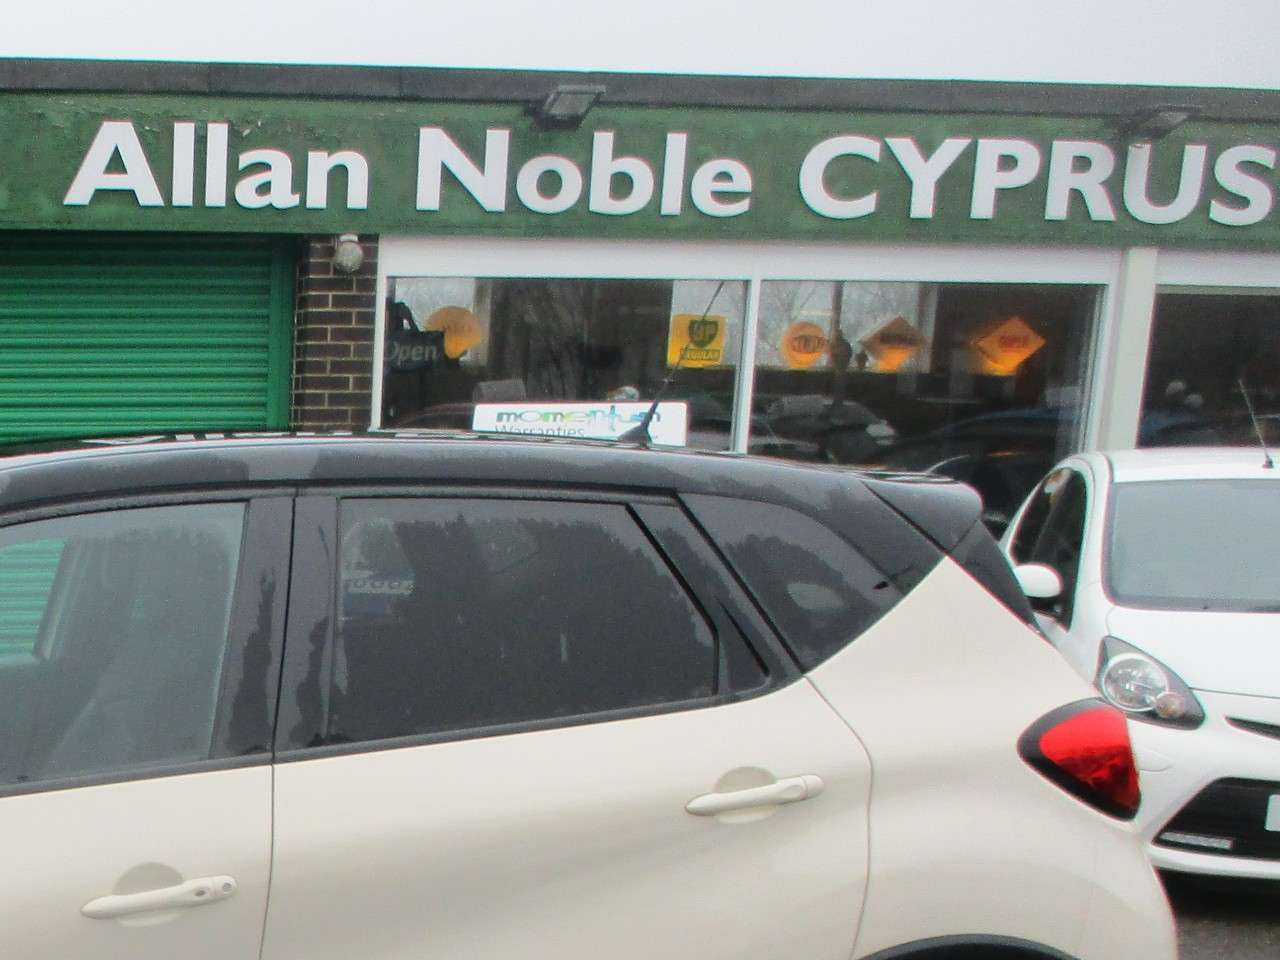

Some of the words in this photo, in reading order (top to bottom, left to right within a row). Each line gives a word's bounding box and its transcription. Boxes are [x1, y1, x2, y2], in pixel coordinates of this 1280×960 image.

[62, 120, 369, 210] Allan
[415, 127, 753, 217] Noble
[798, 135, 1278, 226] CYPRUS
